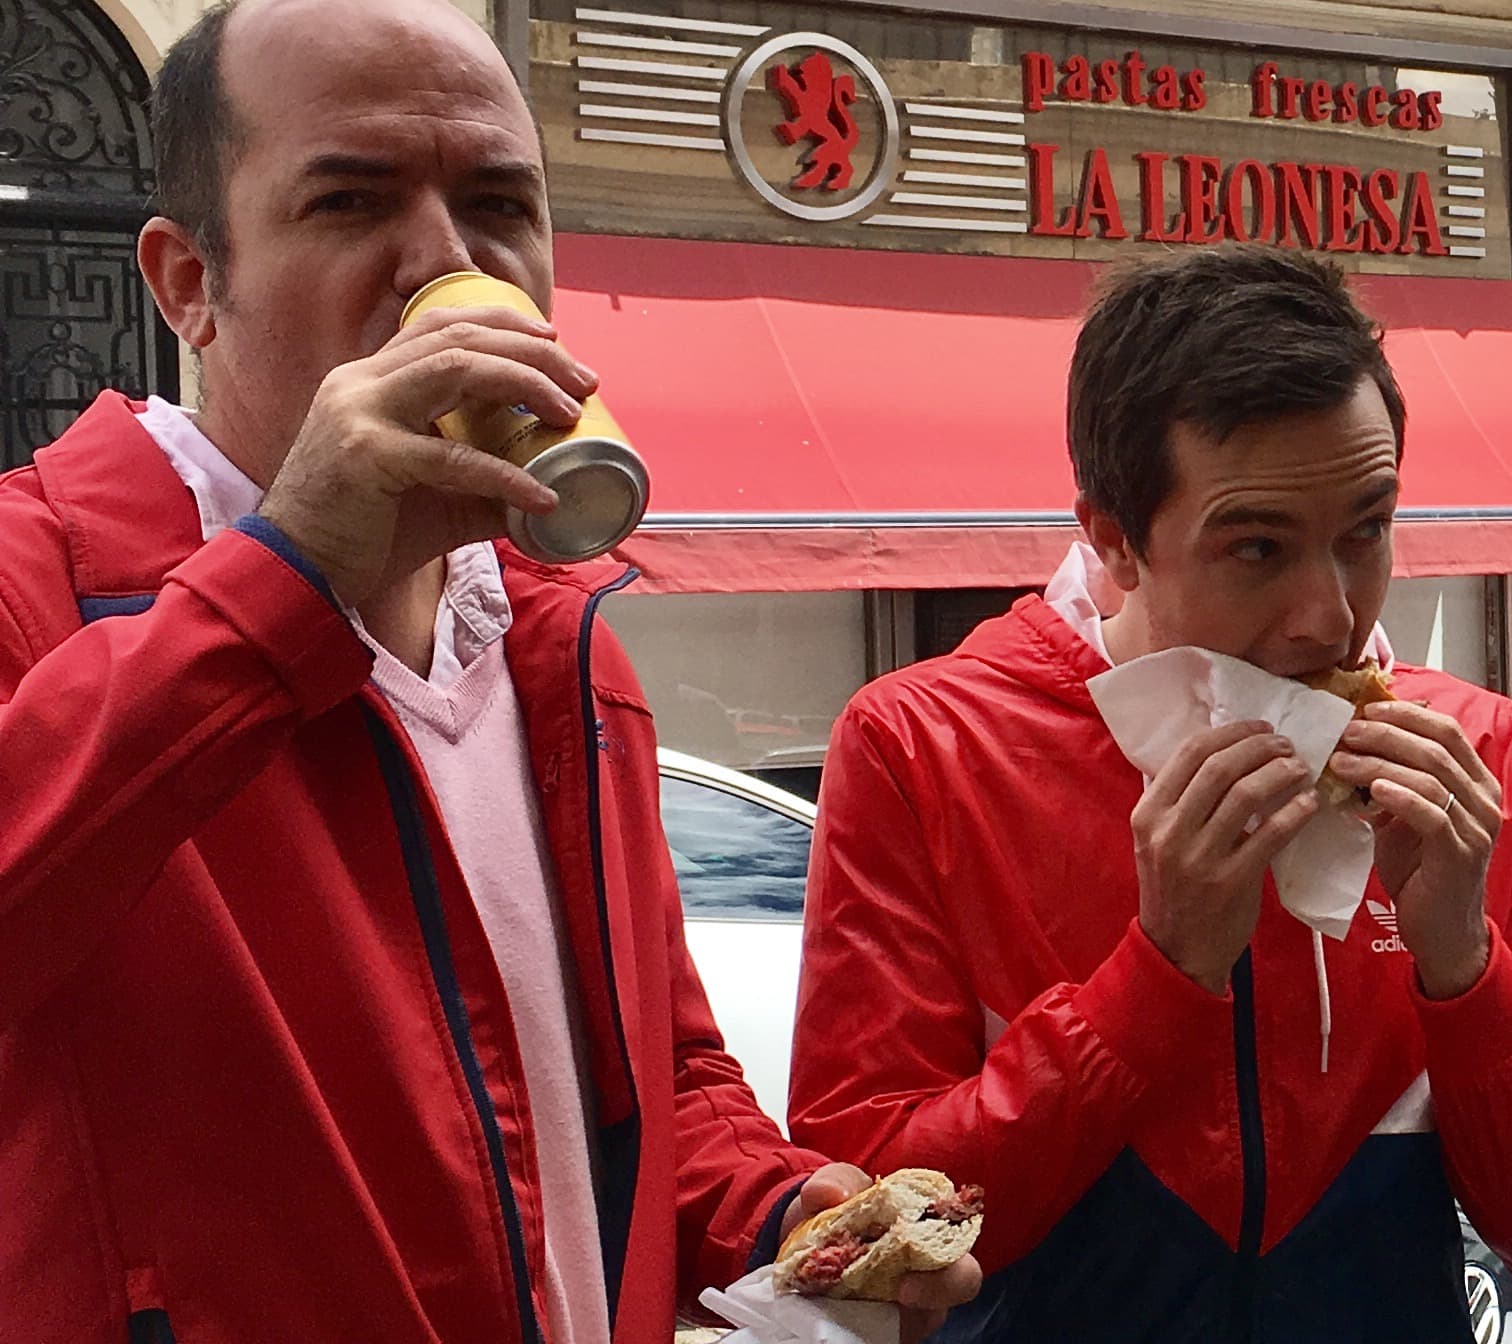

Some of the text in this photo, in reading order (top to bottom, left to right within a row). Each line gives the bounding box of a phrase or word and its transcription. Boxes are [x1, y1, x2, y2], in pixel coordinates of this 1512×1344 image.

[1023, 50, 1443, 131] pastas frescas
[1028, 143, 1450, 256] LA LEONESA
